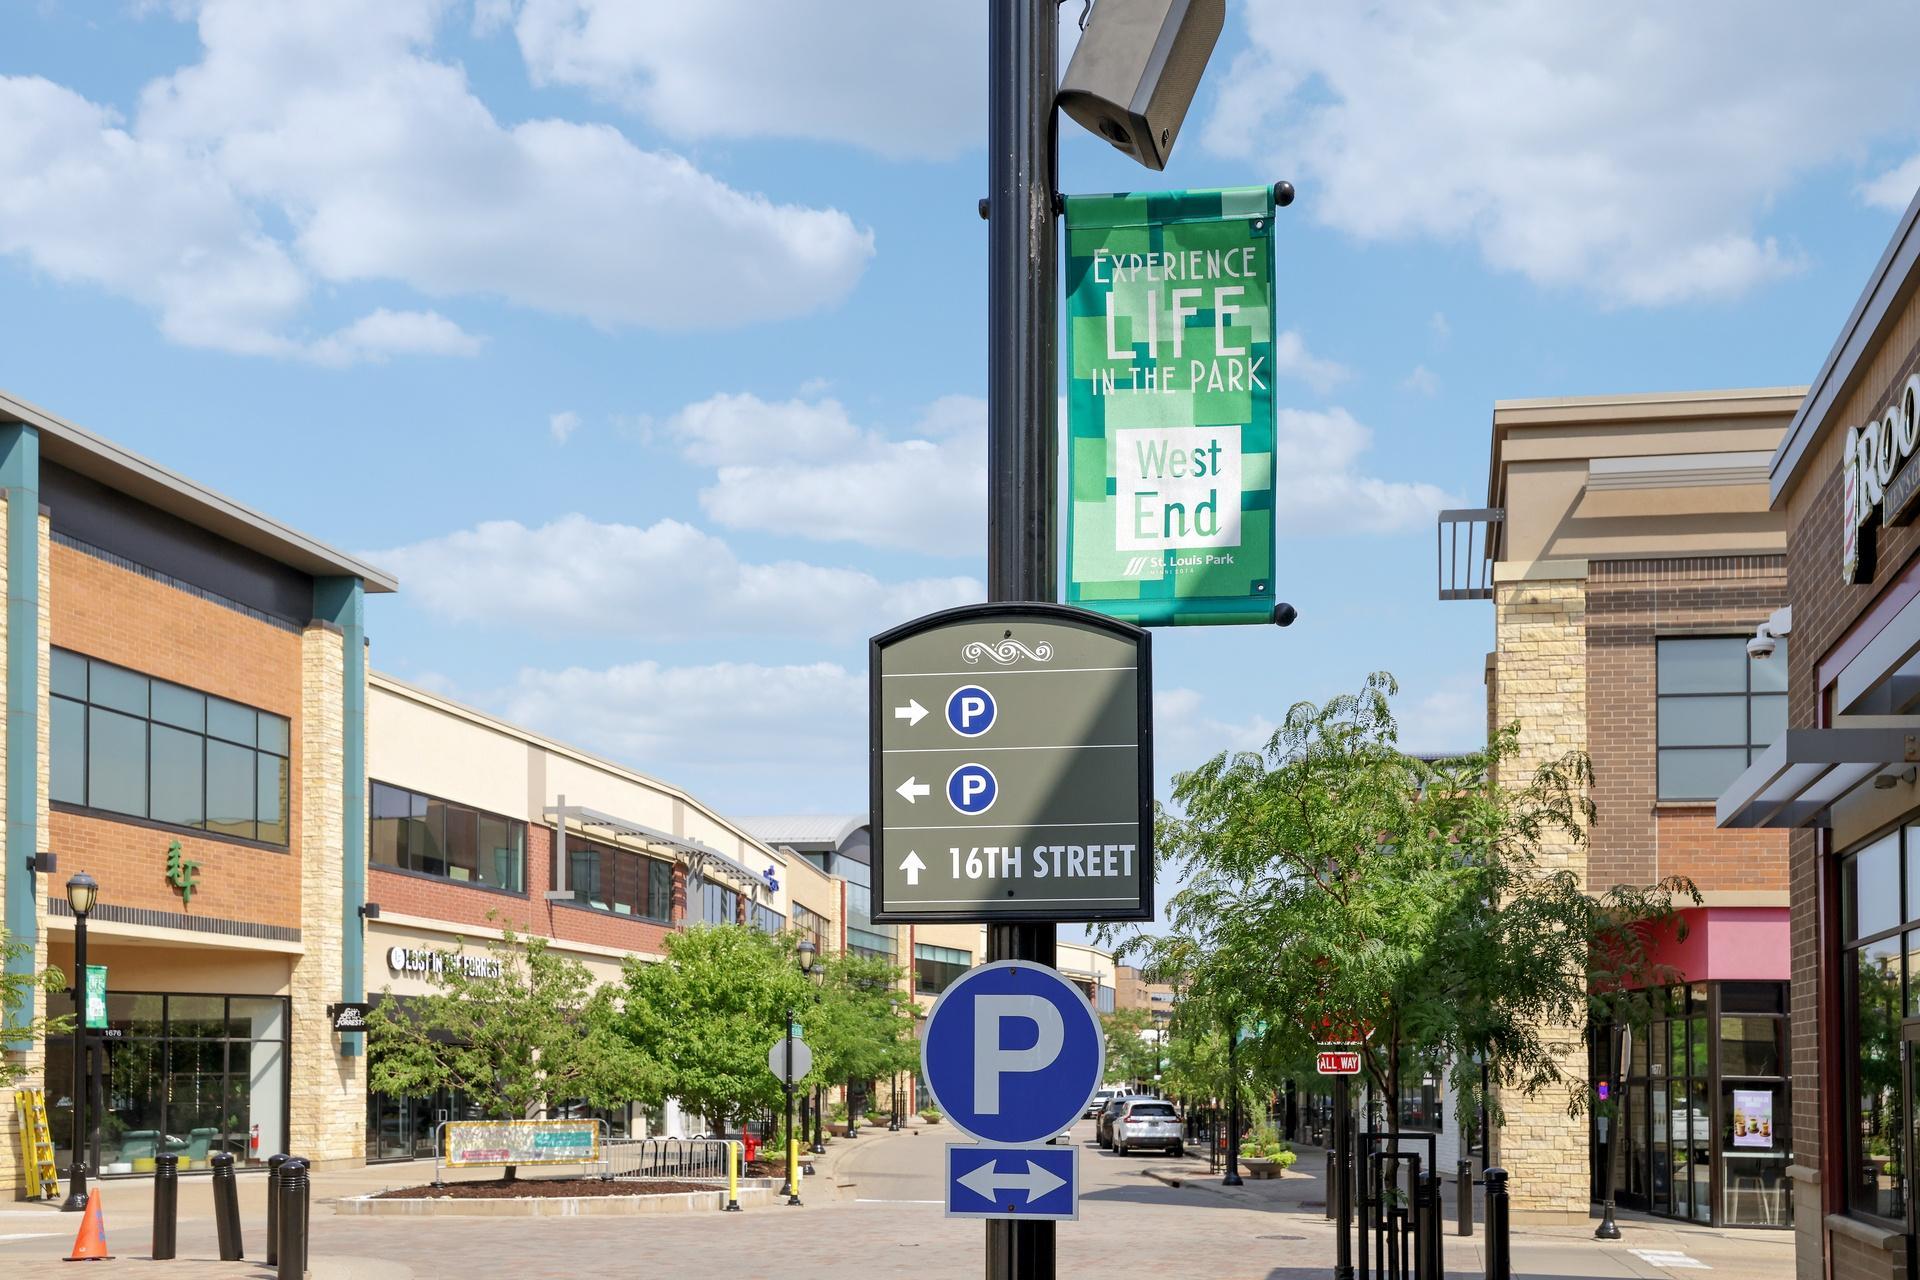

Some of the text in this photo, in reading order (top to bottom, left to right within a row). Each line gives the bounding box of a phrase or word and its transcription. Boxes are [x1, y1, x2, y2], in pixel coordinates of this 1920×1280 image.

[1093, 246, 1257, 284] EXPERIENCE
[1106, 285, 1246, 361] LIFE
[1092, 356, 1267, 396] IN THE PARK
[1136, 438, 1223, 480] West
[1133, 488, 1222, 541] End
[1150, 553, 1234, 568] St. Louis Park
[961, 696, 986, 729] P
[962, 774, 987, 806] P
[949, 844, 1136, 880] 16TH STREET
[405, 948, 431, 971] LOST
[432, 951, 443, 973] IN
[104, 1029, 122, 1037] 1676
[973, 994, 1065, 1115] P
[1320, 1056, 1358, 1070] ALL WAY
